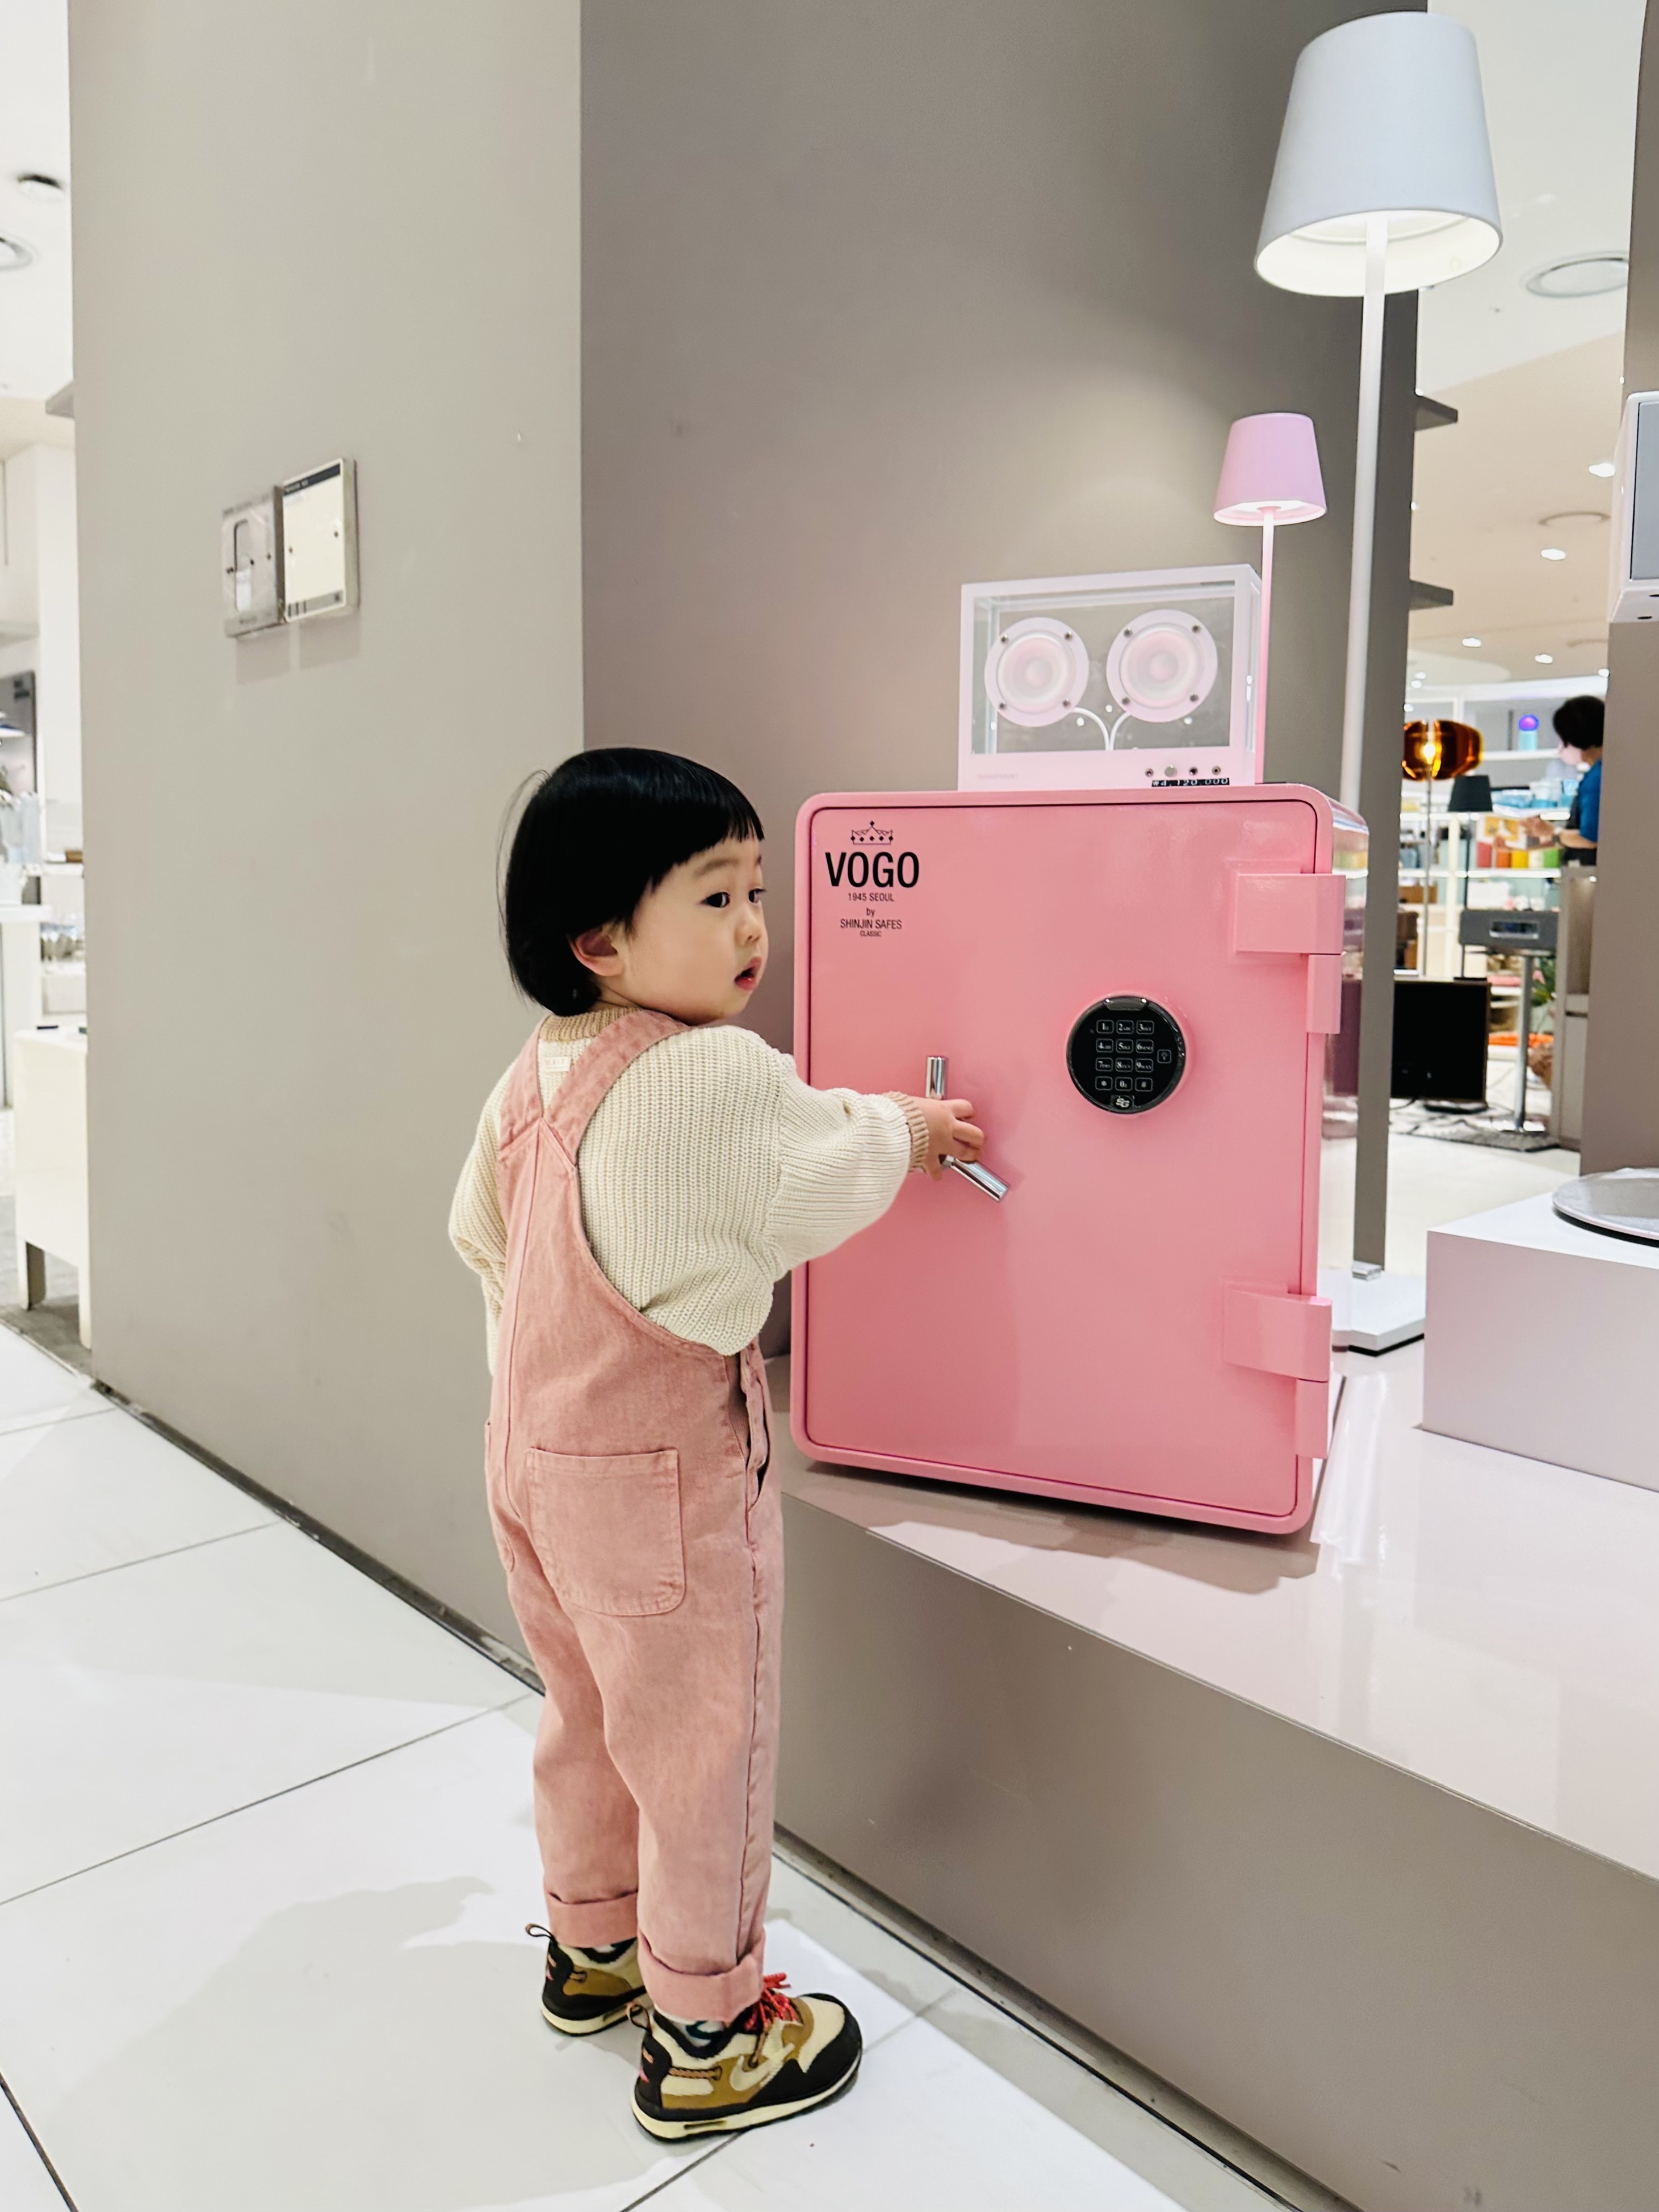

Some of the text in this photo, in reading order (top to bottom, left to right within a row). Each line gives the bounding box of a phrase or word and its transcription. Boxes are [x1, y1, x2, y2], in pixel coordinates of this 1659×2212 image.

[825, 851, 919, 888] VOGO
[848, 893, 894, 902] 1945 SEOUL
[866, 907, 875, 917] by
[840, 918, 902, 929] SHINJIN SAFES
